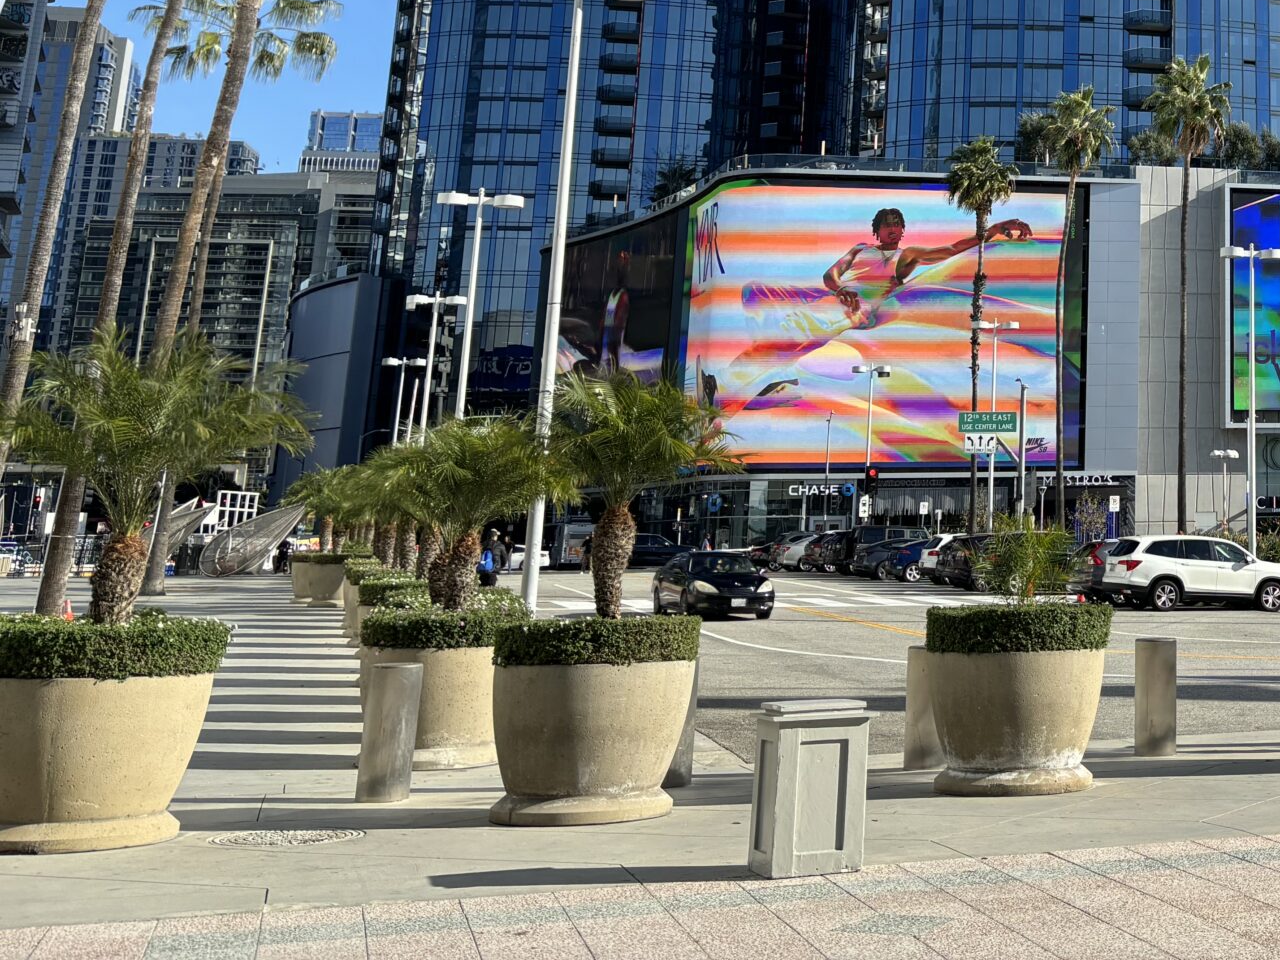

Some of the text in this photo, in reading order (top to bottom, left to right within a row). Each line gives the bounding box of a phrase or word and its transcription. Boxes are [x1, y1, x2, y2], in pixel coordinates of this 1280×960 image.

[1025, 437, 1045, 446] NIKE
[1043, 475, 1113, 486] MSTRO'S
[789, 484, 840, 496] CHASE
